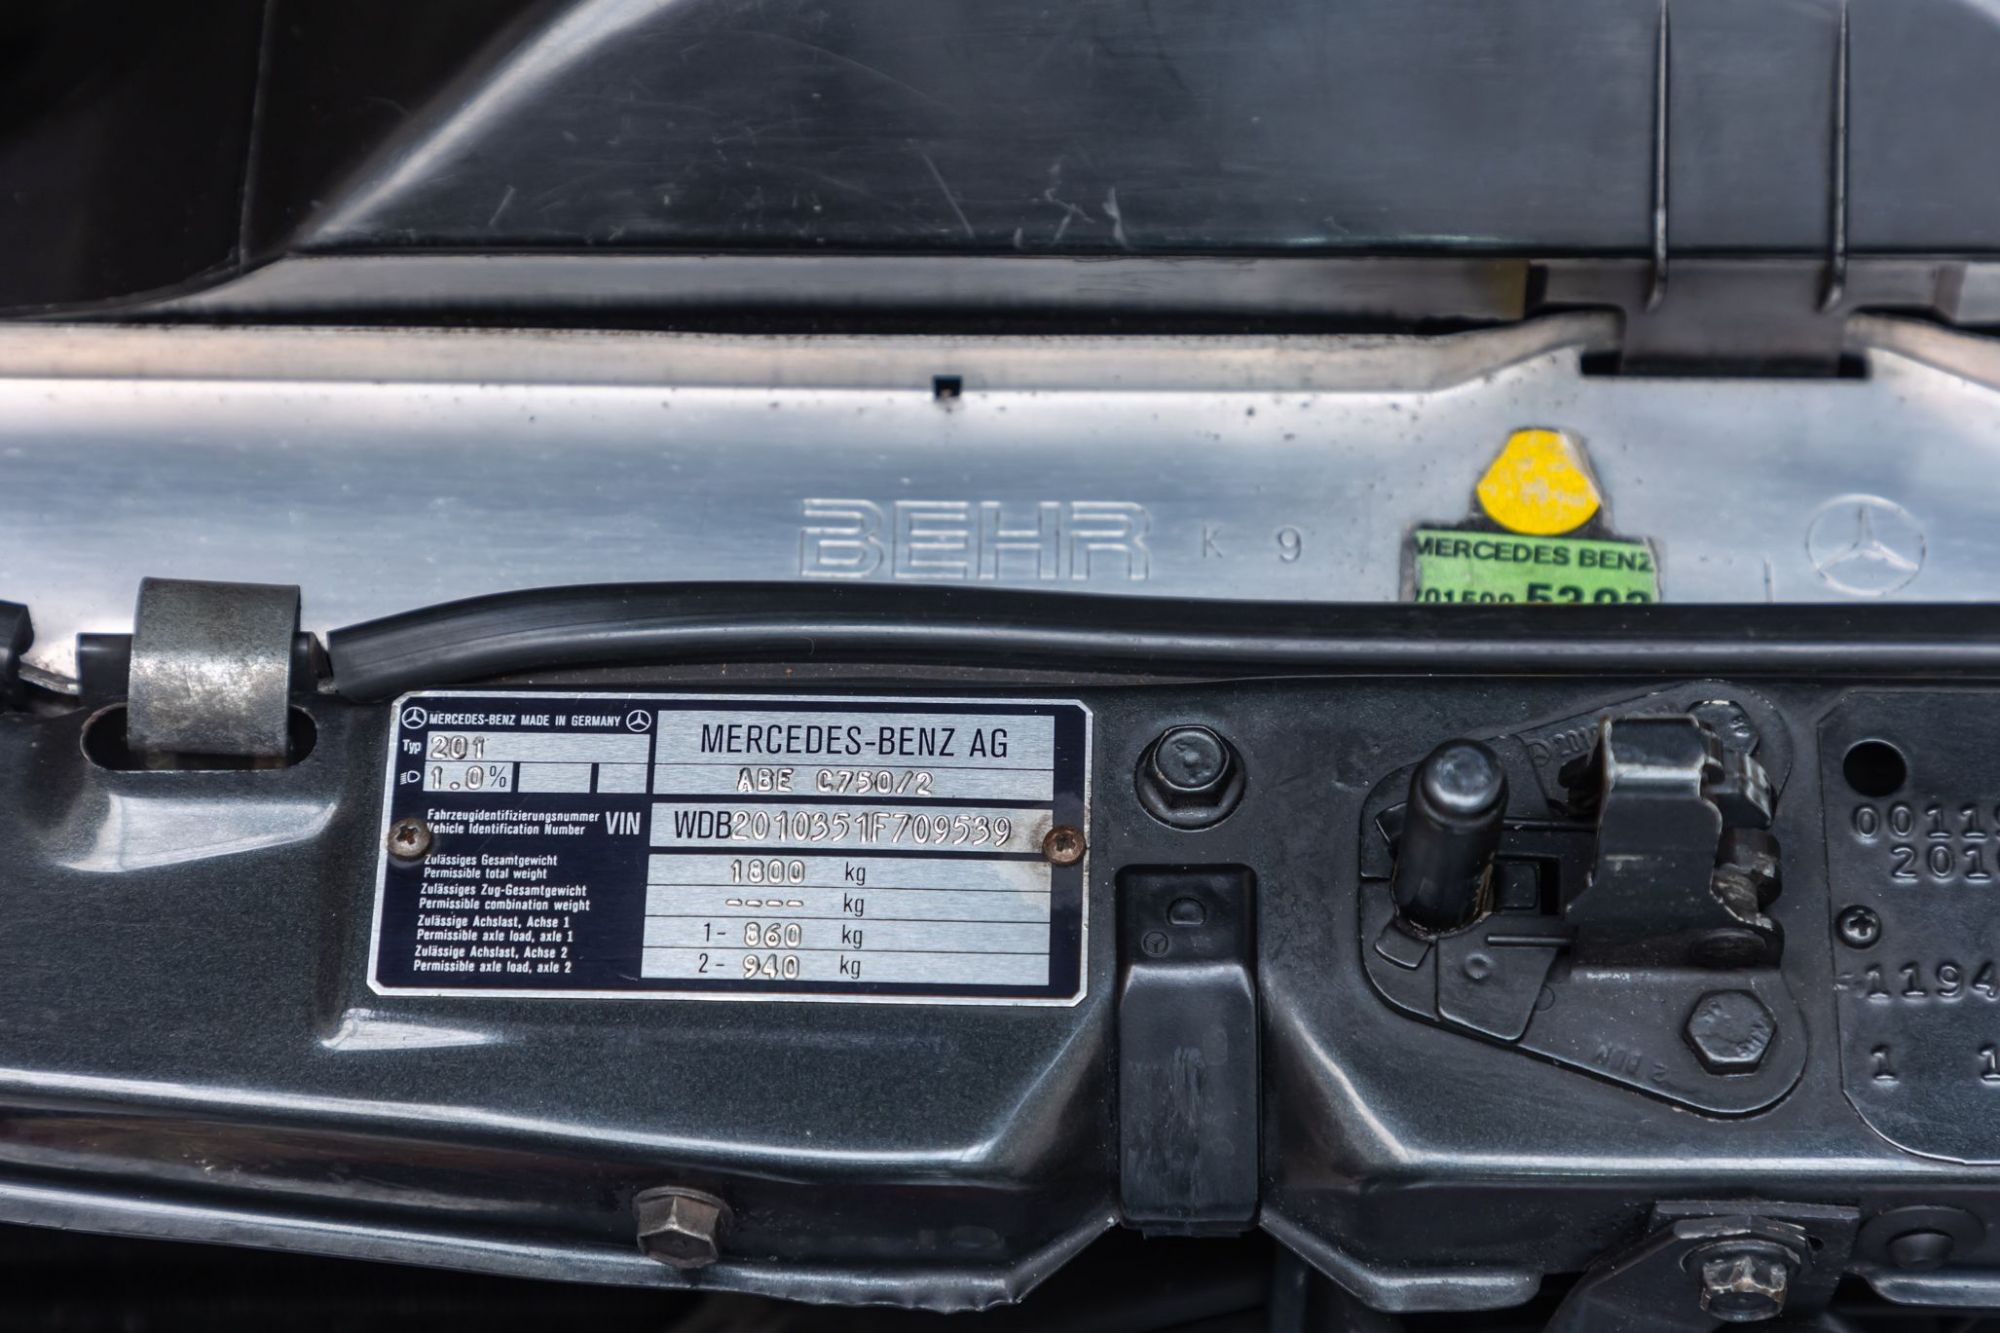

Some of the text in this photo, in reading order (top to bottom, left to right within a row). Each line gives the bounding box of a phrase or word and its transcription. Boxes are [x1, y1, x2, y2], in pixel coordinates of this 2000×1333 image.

[800, 499, 1153, 580] BEHR
[1200, 526, 1303, 564] K 9
[1414, 536, 1655, 573] MERCEDES BENZ
[429, 713, 621, 728] MERCEDES-BENZ MADE IN GERMANY
[402, 735, 486, 761] Typ 201
[700, 724, 1008, 759] MERCEDES-BENZ AG
[431, 765, 507, 790] 1.0%
[736, 767, 934, 797] ABE C750/2
[427, 808, 600, 823] Fahrzeugidentifizierungsnummer
[605, 811, 641, 836] VIN
[1853, 804, 2000, 839] 0011
[427, 822, 586, 835] Vehicle Identification Number
[424, 854, 558, 868] Zulässiges Gesamtgewicht
[730, 859, 866, 886] 1800 kg
[1890, 844, 2000, 881] 201
[424, 867, 547, 881] Permissible total weight
[420, 883, 587, 898] Zulässiges Zug-Gesamtgewicht
[419, 898, 591, 912] Permissible combination weight
[843, 892, 865, 917] kg
[417, 915, 570, 930] Zulässige Achslast, Achse 1
[743, 922, 802, 948] 860
[842, 924, 863, 948] kg
[416, 928, 574, 943] Permissible axle load, axle 1
[415, 945, 568, 959] Zulässige Achslast, Achse 2
[413, 960, 572, 974] Permissible axle load, axle 2
[742, 954, 800, 979] 940
[839, 955, 861, 979] kg
